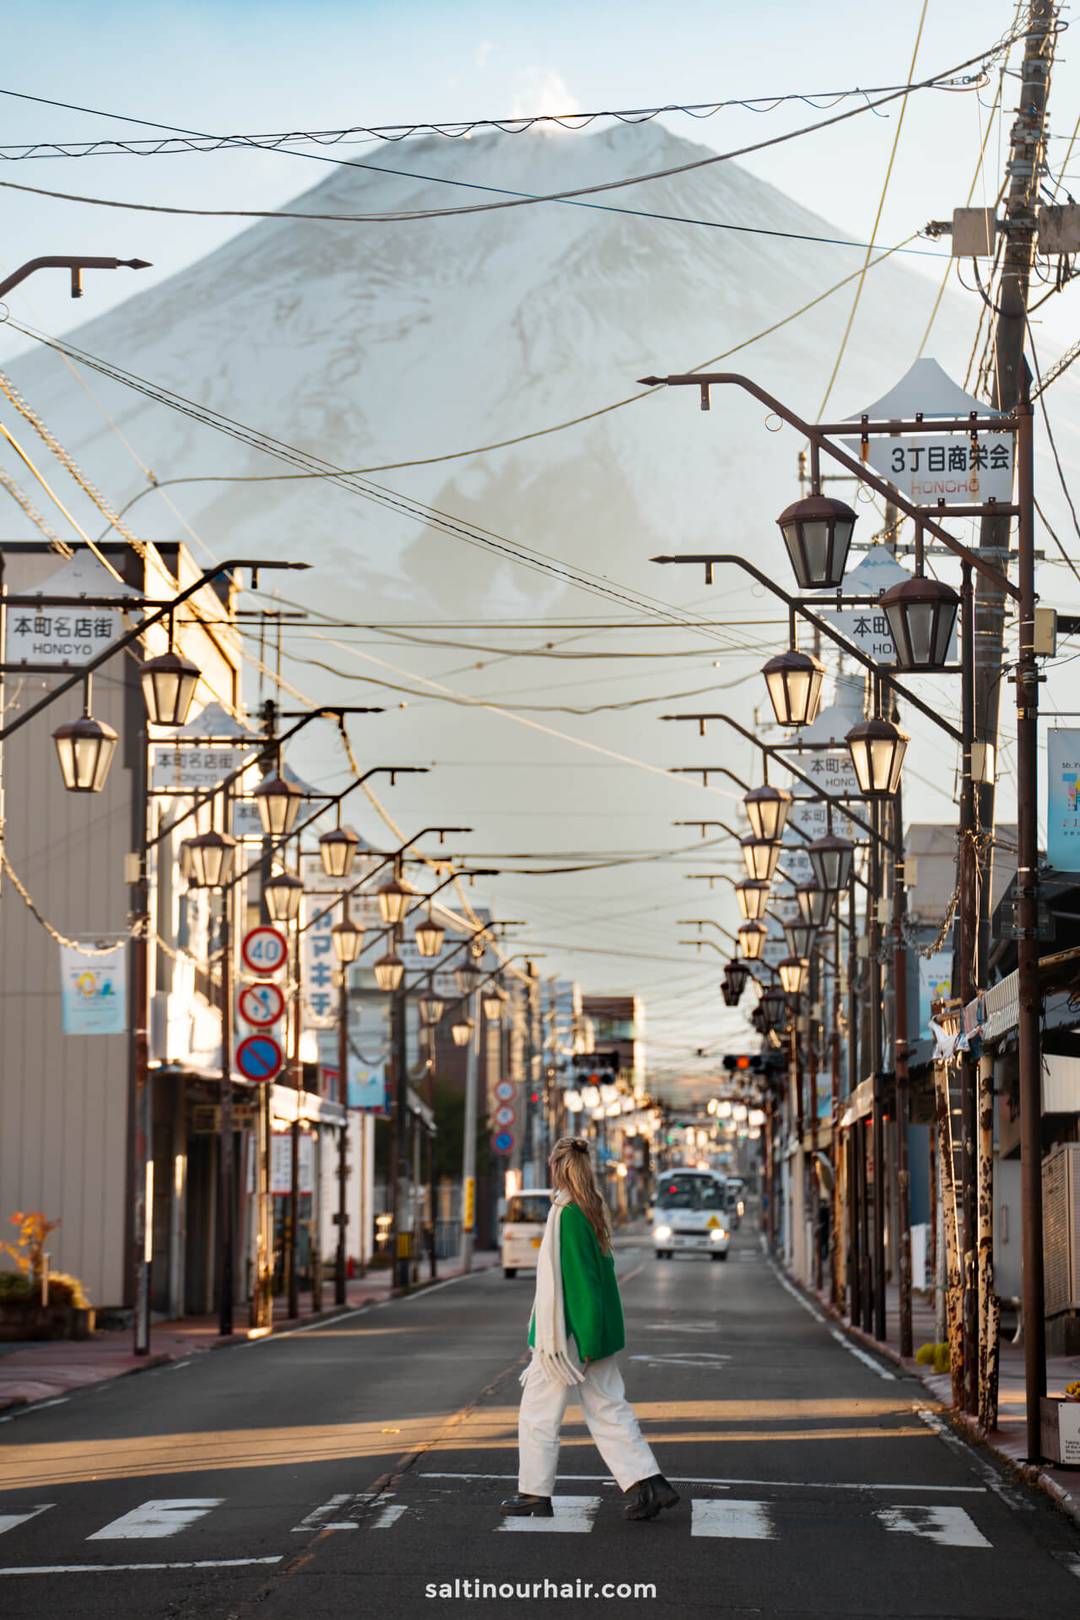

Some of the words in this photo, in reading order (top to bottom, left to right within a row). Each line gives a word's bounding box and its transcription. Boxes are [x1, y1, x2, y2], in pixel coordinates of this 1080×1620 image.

[891, 443, 1009, 473] 3丁目商栄会
[14, 616, 113, 638] 本町名店街
[251, 940, 280, 961] 40
